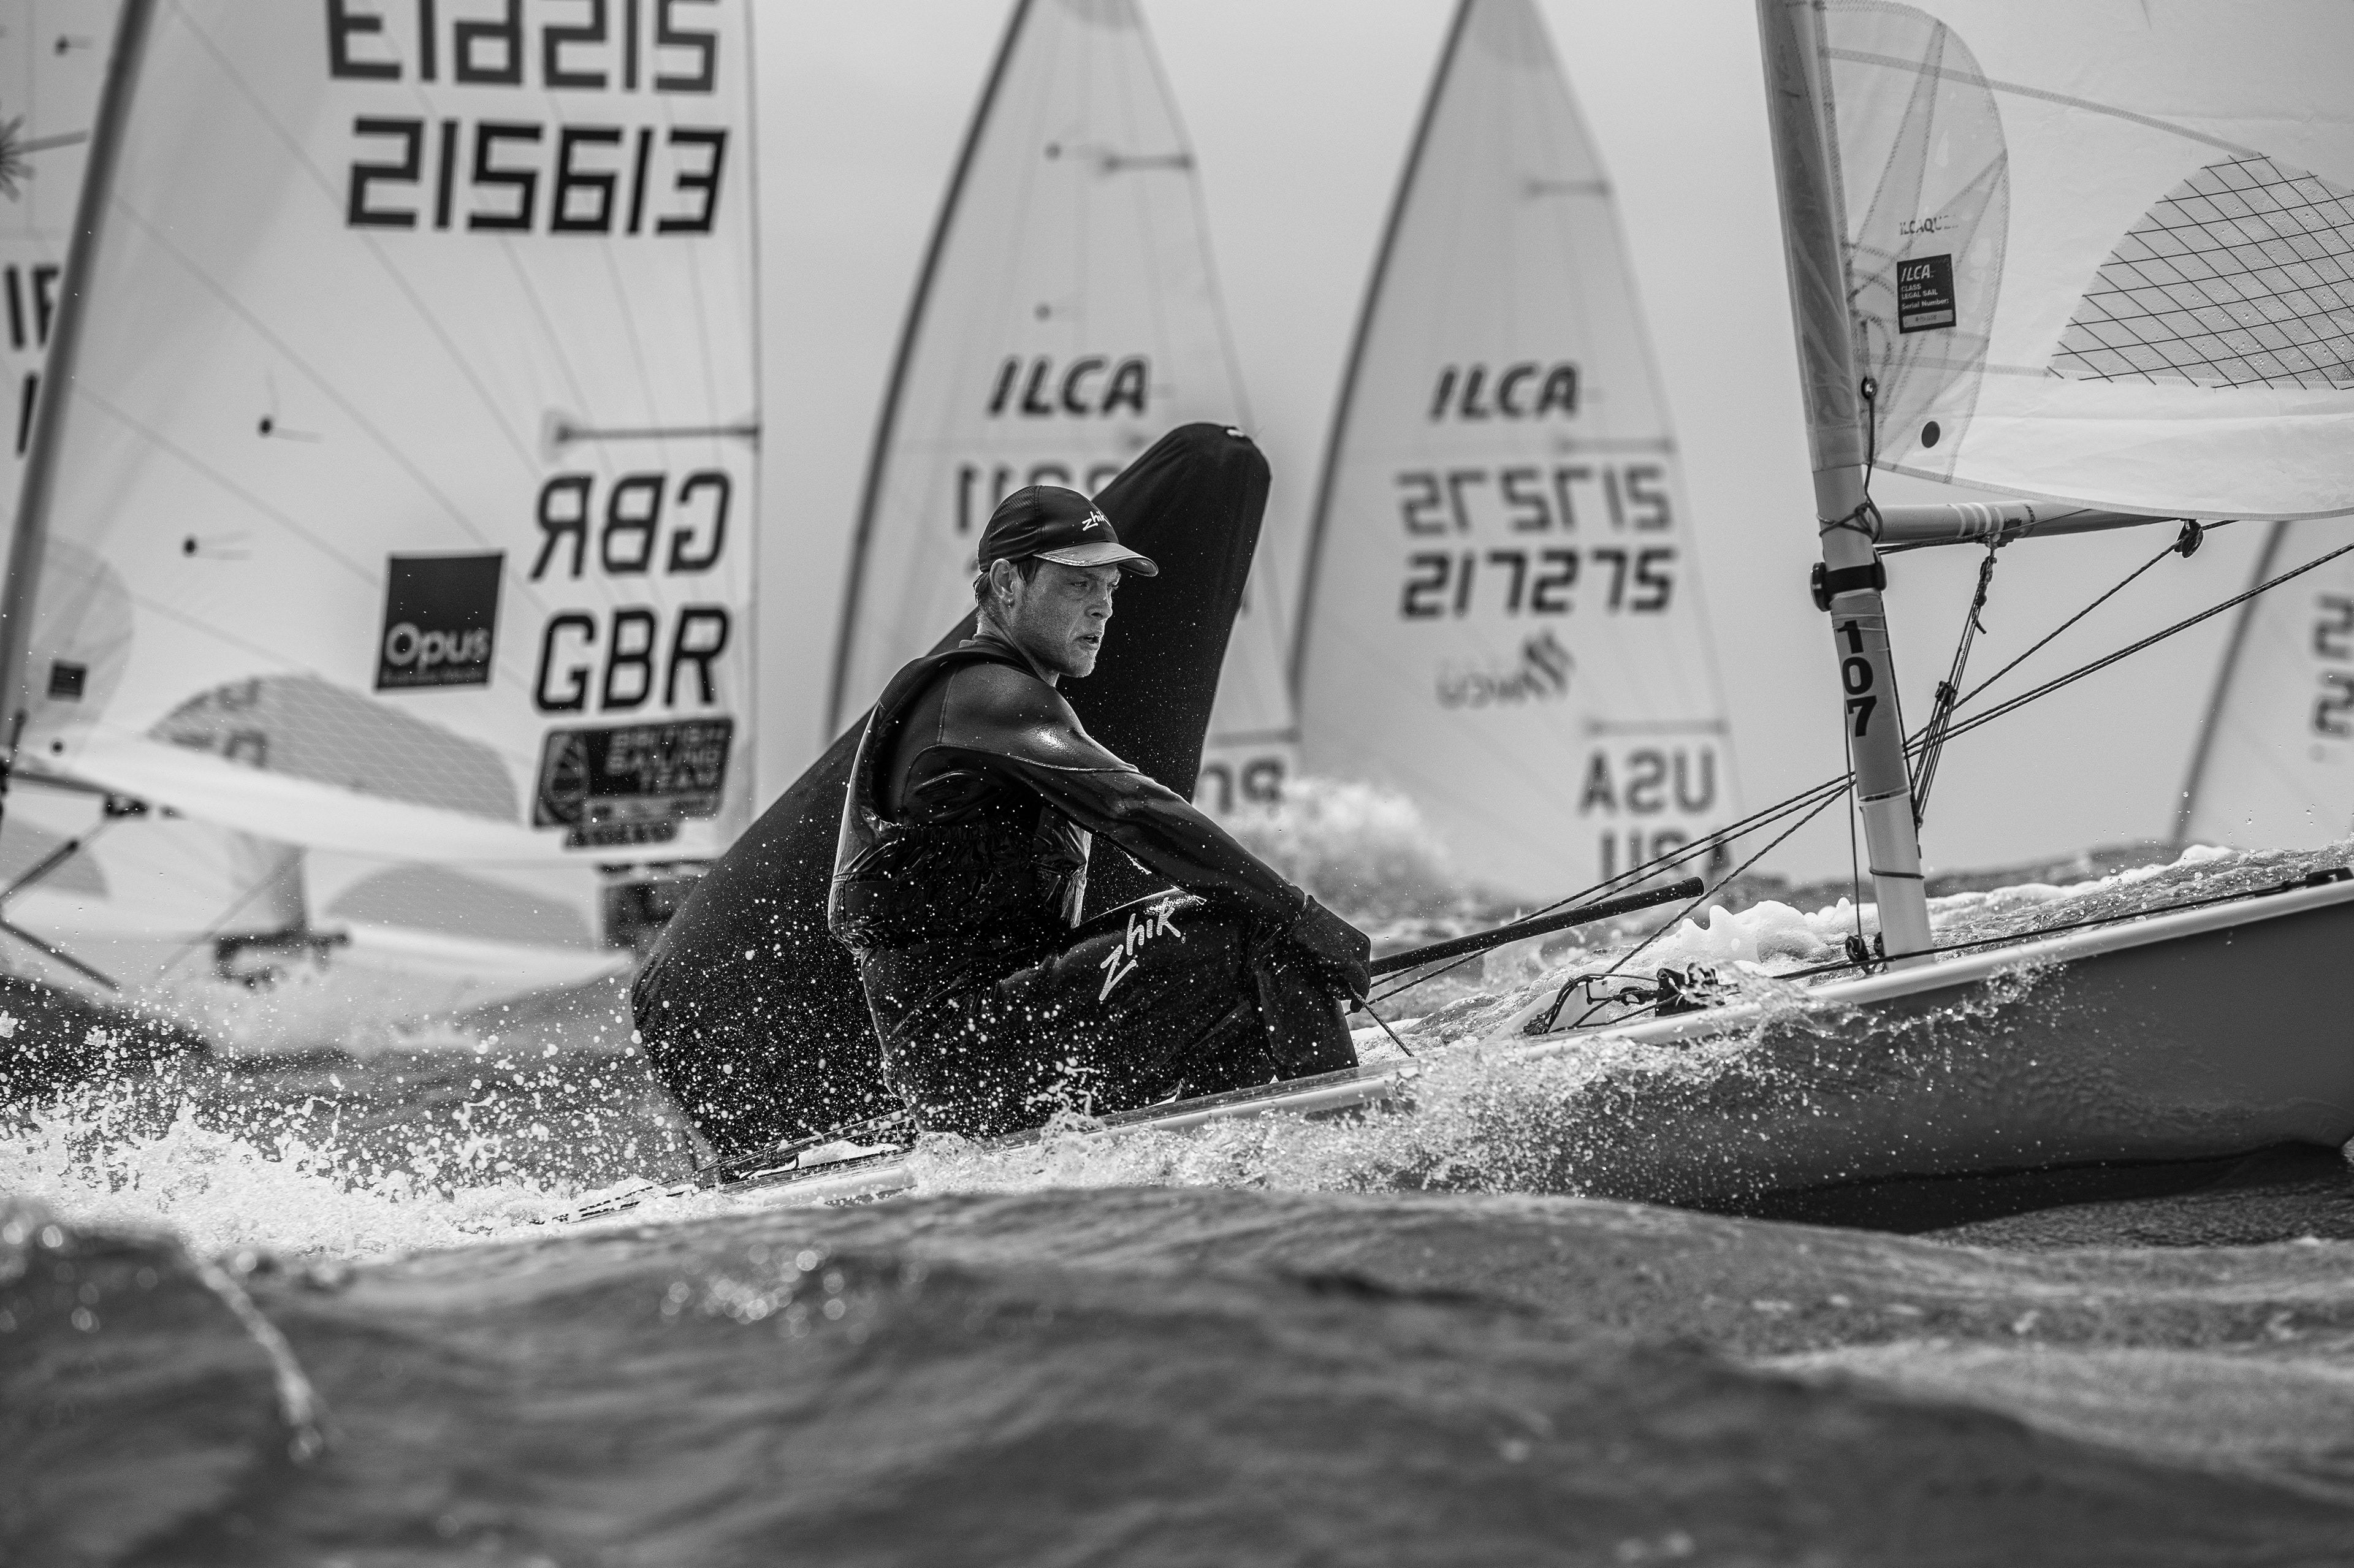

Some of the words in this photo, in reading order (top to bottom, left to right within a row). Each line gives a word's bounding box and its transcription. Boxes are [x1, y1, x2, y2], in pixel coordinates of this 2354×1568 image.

[345, 116, 729, 237] 215613
[1901, 264, 1931, 282] ILCA
[1902, 283, 1922, 292] CLASS
[1902, 291, 1922, 300] LEGAL
[1902, 301, 1921, 310] Serial
[987, 354, 1151, 417] ILCA
[1430, 362, 1581, 423] ILCA
[1400, 546, 1678, 621] 217275
[385, 621, 491, 673] Opus
[533, 603, 733, 716] GBR
[1837, 619, 1878, 737] 107
